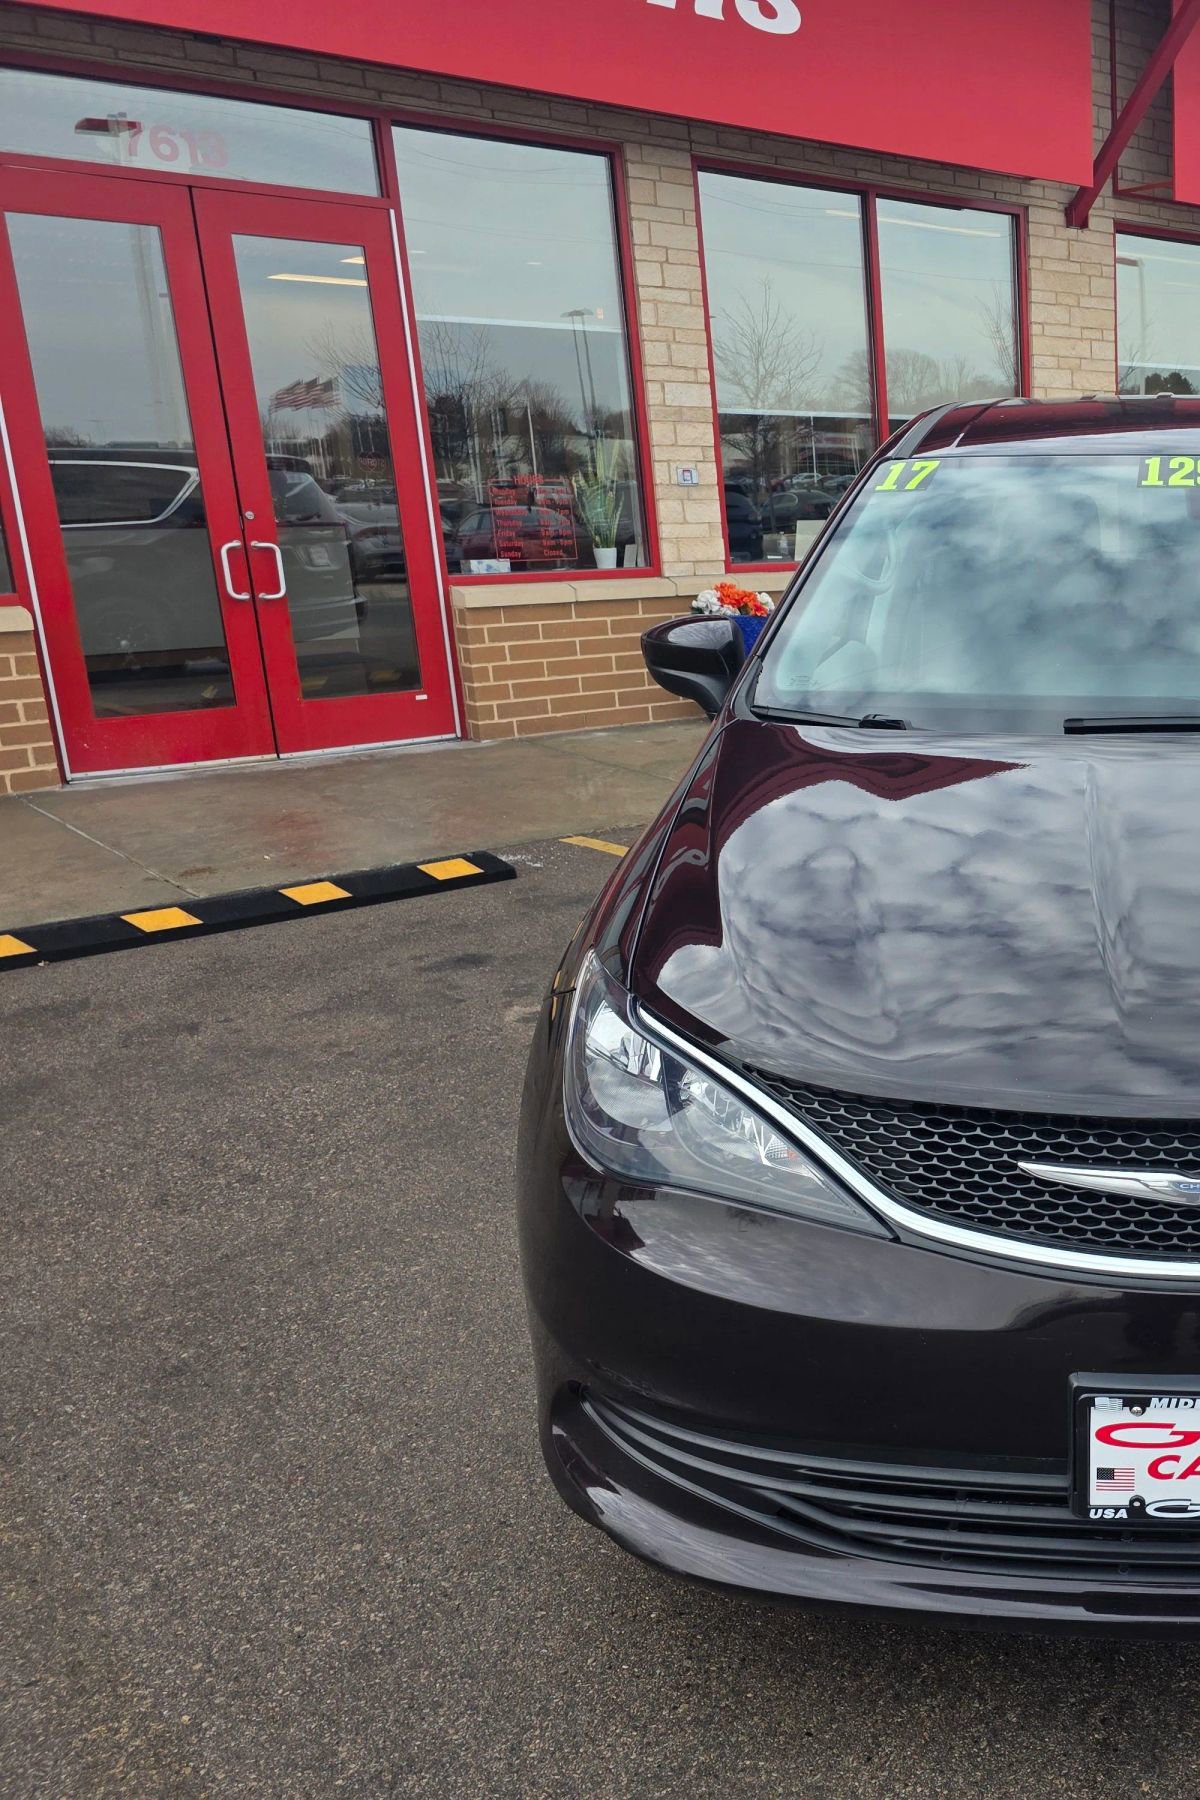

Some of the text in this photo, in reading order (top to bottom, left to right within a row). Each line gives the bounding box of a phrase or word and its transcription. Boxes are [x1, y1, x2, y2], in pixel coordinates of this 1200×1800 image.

[875, 460, 940, 491] 17
[500, 551, 521, 559] Sunday
[1089, 1508, 1128, 1519] USA
